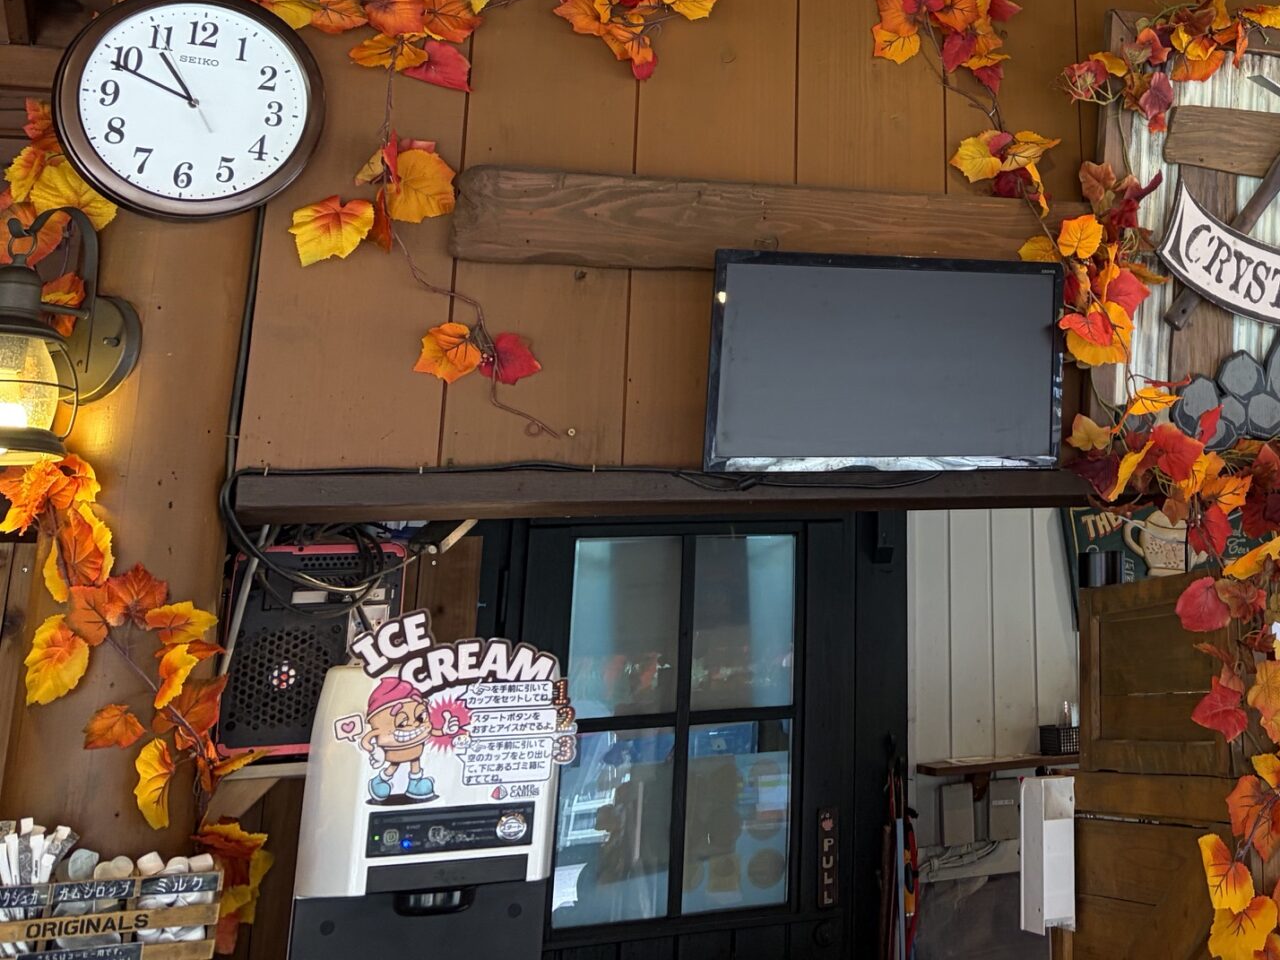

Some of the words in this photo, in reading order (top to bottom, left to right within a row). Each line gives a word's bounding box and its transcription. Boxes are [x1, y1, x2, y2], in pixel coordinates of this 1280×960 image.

[148, 25, 173, 52] 11
[187, 21, 219, 48] 12
[111, 46, 143, 73] 10
[179, 54, 219, 67] SEIKO
[235, 37, 247, 61] 1
[258, 66, 277, 91] 2
[99, 80, 120, 107] 9
[264, 101, 283, 127] 3
[104, 117, 125, 144] 8
[133, 146, 154, 175] 7
[248, 134, 268, 161] 4
[173, 162, 193, 189] 6
[216, 156, 235, 183] 5
[352, 613, 431, 674] ICE
[401, 642, 554, 691] CREAM
[474, 712, 541, 723] スタートボタンを
[156, 876, 204, 892] ミルク
[822, 838, 834, 905] PULL
[59, 881, 130, 900] ガムシロップ
[26, 913, 149, 939] ORIGINALS
